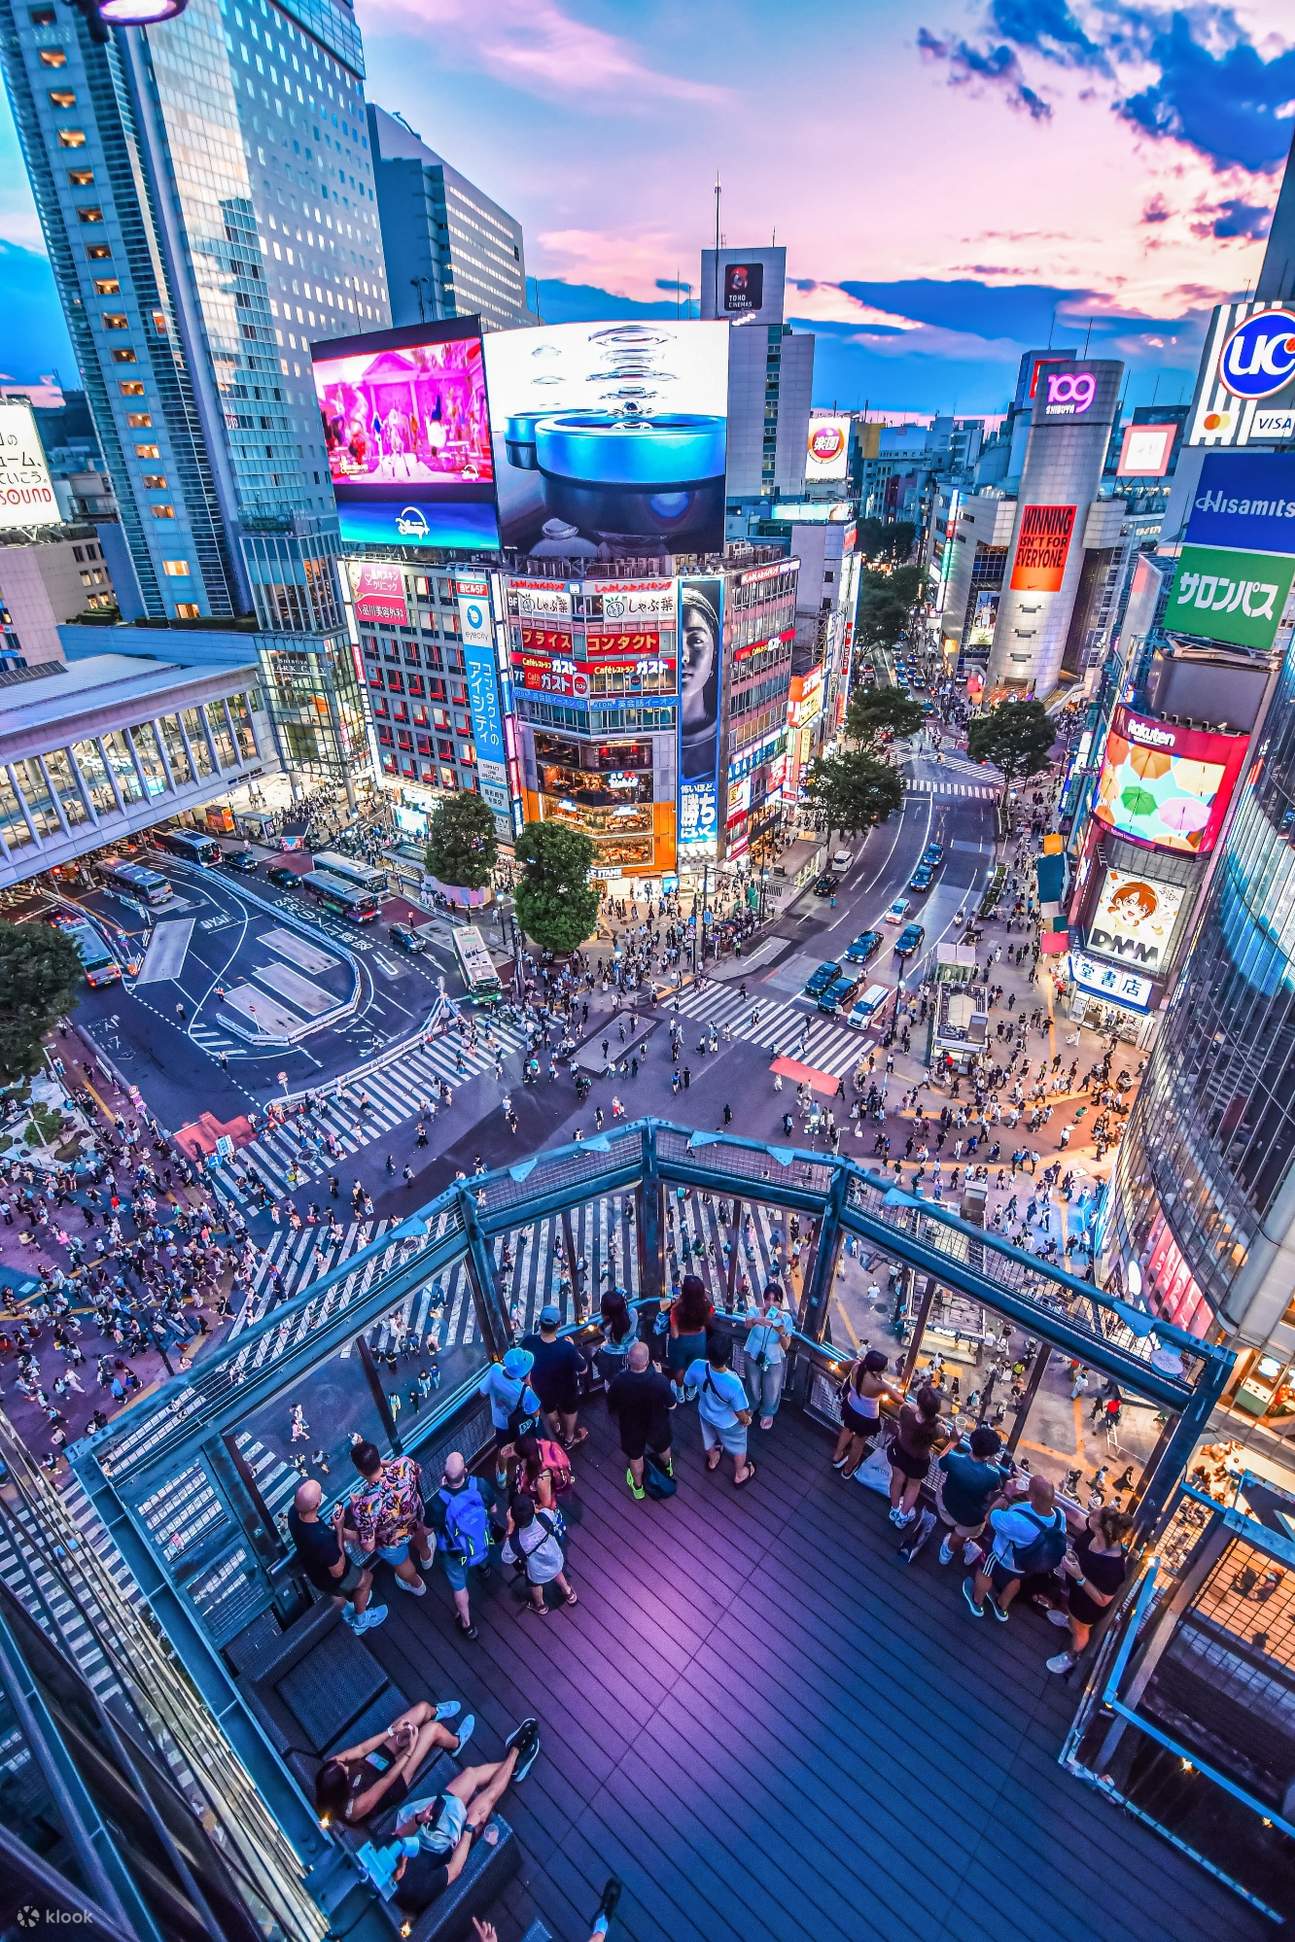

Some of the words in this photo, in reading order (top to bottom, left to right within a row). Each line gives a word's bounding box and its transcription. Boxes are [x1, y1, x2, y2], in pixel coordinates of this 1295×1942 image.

[1047, 373, 1097, 414] 109
[1045, 404, 1076, 415] SHIBUYA
[1258, 417, 1293, 431] VISA
[1194, 489, 1295, 519] Hisamits
[1022, 507, 1073, 536] WINNING
[1019, 536, 1045, 548] ISN'T
[1047, 537, 1068, 549] FOR
[1016, 549, 1065, 569] EVERYONE.
[628, 595, 674, 613] しゃぶ葉
[1178, 570, 1280, 621] サロンパス
[522, 630, 572, 649] プライス
[587, 634, 658, 651] コンタクト
[301, 665, 327, 673] CIY
[514, 670, 525, 682] 7F
[552, 659, 578, 675] ガスト
[636, 659, 669, 675] ガスト
[541, 673, 571, 692] ガスト
[469, 660, 489, 745] アイシティ
[1127, 718, 1176, 747] Rakuten
[680, 793, 716, 827] 勝ち
[1090, 927, 1158, 968] DMM
[1079, 962, 1142, 997] 堂書店
